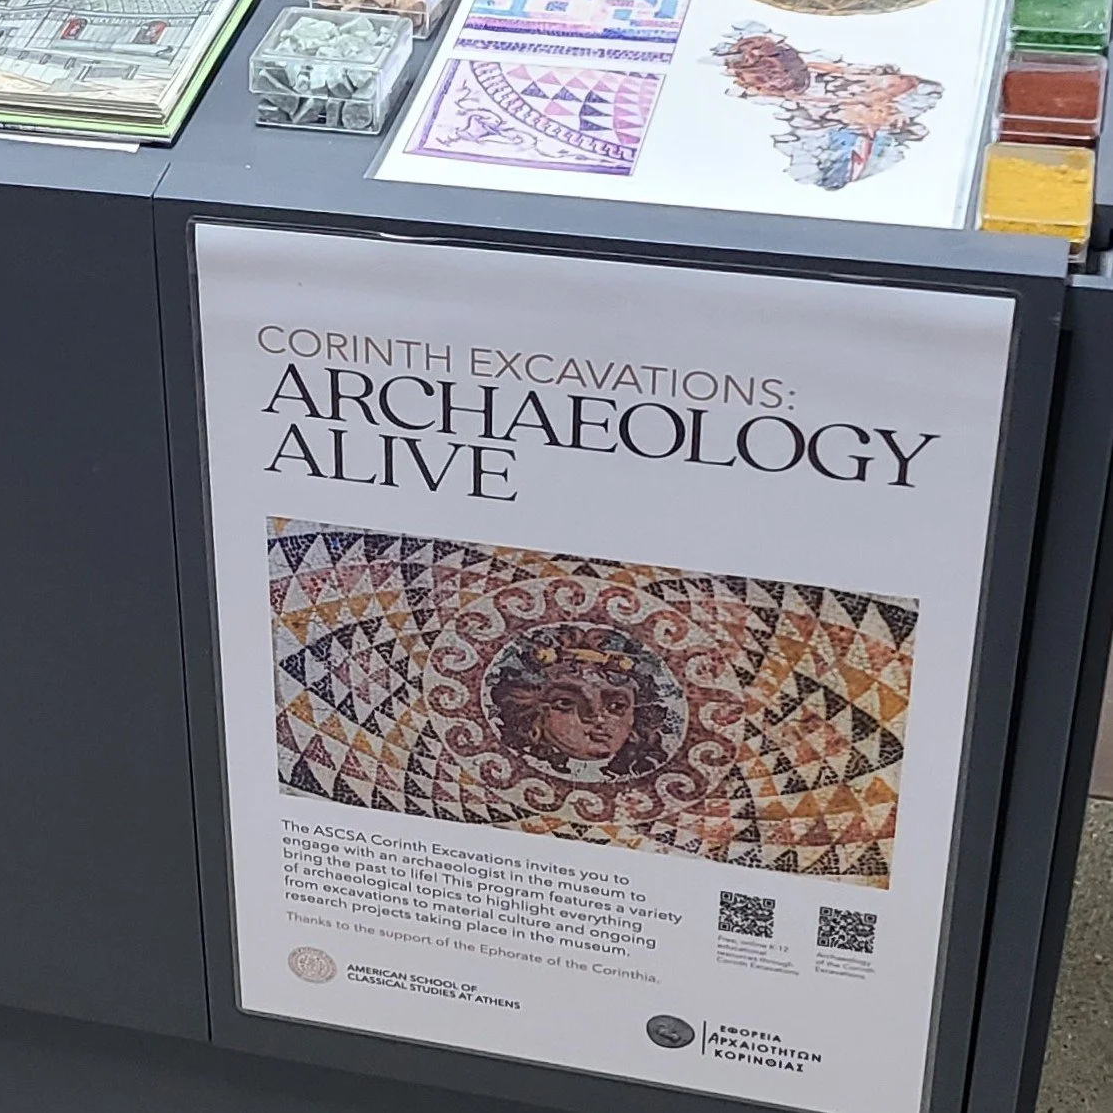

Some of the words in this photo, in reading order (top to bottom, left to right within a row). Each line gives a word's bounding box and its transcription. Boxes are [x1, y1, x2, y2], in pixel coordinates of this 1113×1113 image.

[257, 324, 451, 373] CORINTH
[469, 346, 797, 410] EXCAVATIONS:
[261, 363, 941, 487] ARCHAEOLOGY
[264, 423, 517, 502] ALIVE
[281, 819, 309, 833] The
[313, 825, 366, 843] ASCSA
[370, 834, 426, 852] Corinth
[432, 843, 521, 867] Excavations
[526, 858, 575, 876] invites
[579, 870, 608, 881] you
[613, 874, 629, 885] to
[282, 836, 339, 853] engage
[344, 846, 374, 858] with
[379, 852, 396, 861] an
[402, 856, 504, 879] archaeologist
[510, 870, 522, 882] in
[528, 873, 552, 887] the
[558, 881, 624, 898] museum
[630, 891, 645, 901] to
[283, 847, 322, 865] bring
[327, 855, 350, 867] the
[355, 862, 386, 874] past
[391, 866, 405, 876] to
[410, 868, 436, 882] life!
[442, 873, 472, 888] This
[477, 882, 544, 899] program
[549, 890, 611, 910] features
[616, 904, 624, 912] a
[629, 906, 682, 924] variety
[283, 862, 298, 872] of
[303, 867, 411, 892] archaeological
[416, 884, 461, 900] topics
[466, 893, 481, 903] to
[486, 894, 554, 916] highlight
[559, 910, 641, 932] everything
[284, 874, 317, 890] from
[322, 884, 408, 905] excavations
[413, 898, 427, 908] to
[433, 902, 493, 919] material
[498, 913, 550, 928] culture
[555, 923, 584, 935] and
[589, 929, 655, 949] ongoing
[285, 891, 346, 908] research
[352, 902, 411, 919] projects
[415, 912, 461, 930] taking
[466, 920, 507, 935] place
[512, 927, 524, 938] in
[530, 930, 554, 943] the
[559, 937, 629, 956] museum.
[286, 911, 331, 927] Thanks
[336, 920, 349, 930] to
[354, 923, 374, 934] the
[379, 929, 430, 944] support
[435, 937, 449, 947] of
[453, 940, 475, 951] the
[479, 943, 542, 962] Ephorate
[546, 956, 560, 965] of
[565, 959, 587, 970] the
[347, 964, 407, 981] AMERICAN
[410, 975, 459, 990] SCHOOL
[461, 983, 478, 993] OF
[347, 973, 408, 990] CLASSICAL
[410, 983, 456, 999] STUDIES
[458, 992, 473, 1001] AT
[474, 995, 521, 1010] ATHENS
[708, 1032, 822, 1063] ΑΡΧΑΙΟΤΗΤΩΝ
[714, 1048, 804, 1073] ΚΟΡΙΝΘΙΑΣ
[720, 1025, 781, 1043] ΕΦΟΡΕΙΑ
